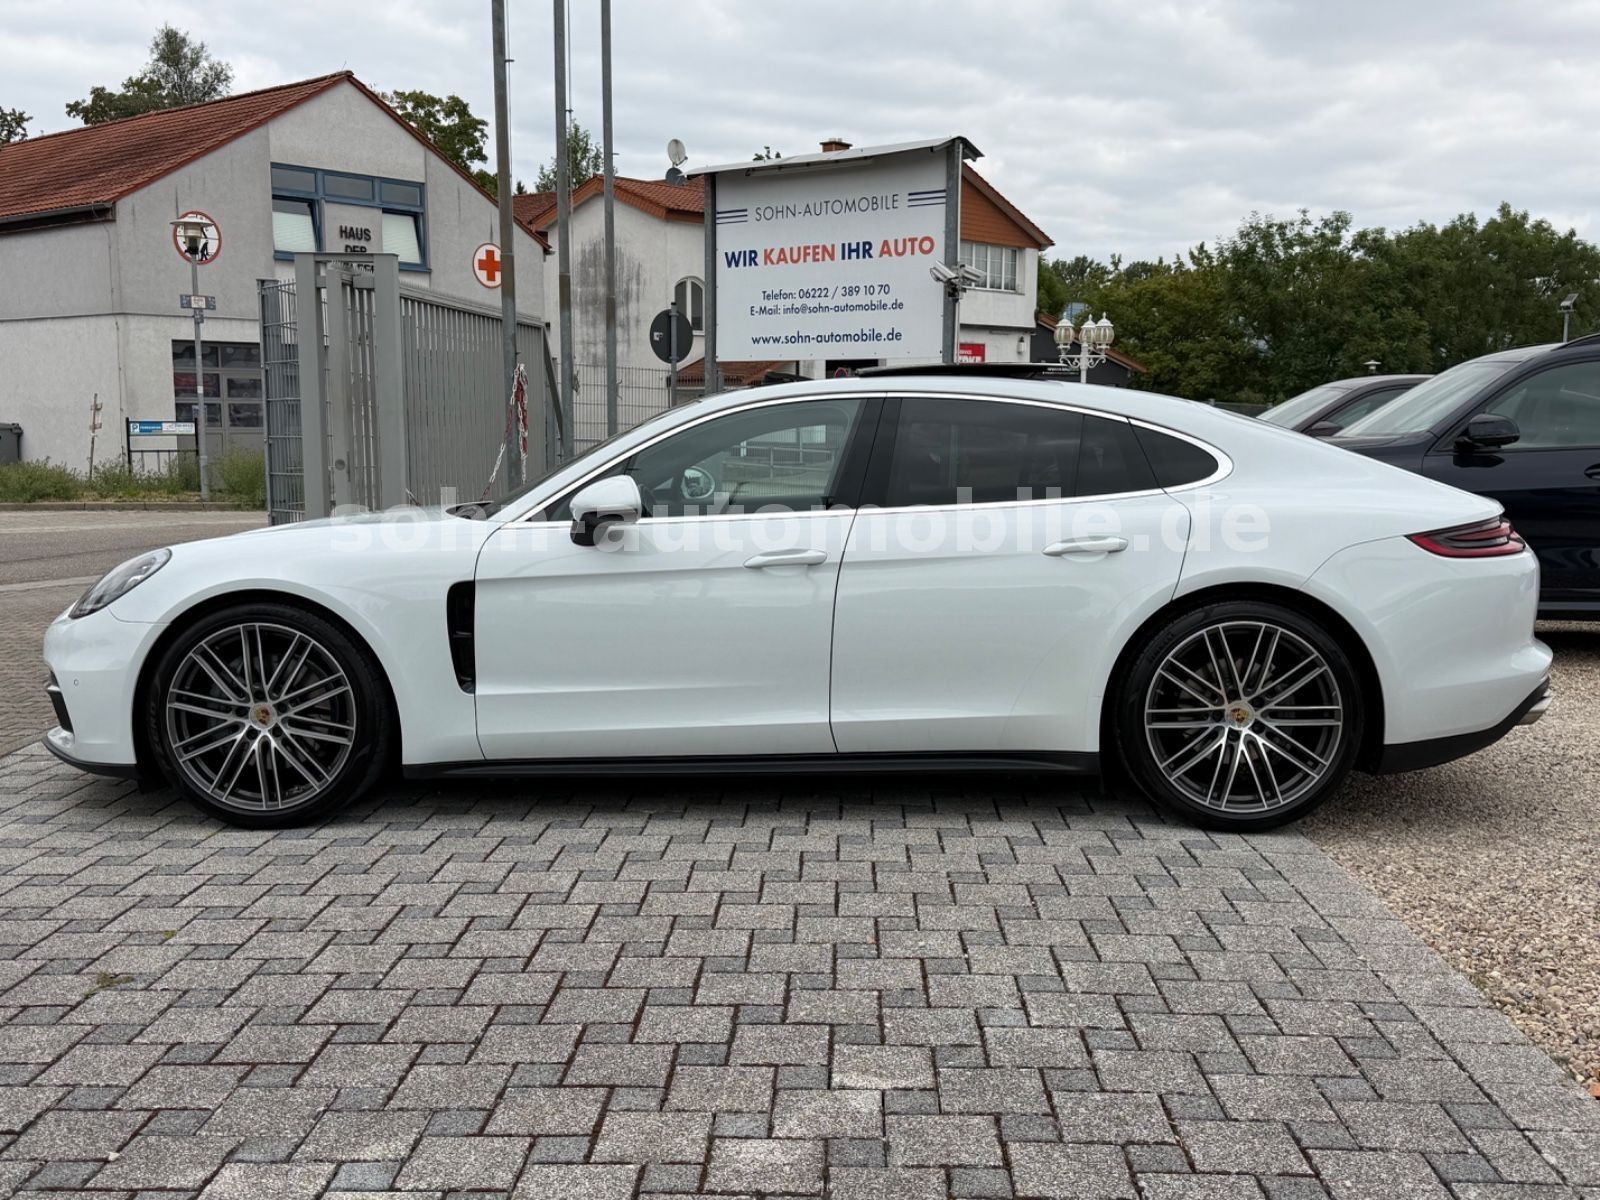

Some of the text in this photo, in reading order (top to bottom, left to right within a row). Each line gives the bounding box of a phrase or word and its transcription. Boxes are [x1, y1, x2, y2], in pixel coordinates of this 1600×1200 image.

[755, 194, 899, 221] SOHN-AUTOMOBILE
[339, 225, 372, 242] HAUS
[724, 235, 935, 268] WIR KAUFEN IHR AUTO
[761, 283, 890, 301] Telefon: 06222 / 389 10 70
[750, 299, 904, 316] E-Mail: info@sohn-automobile.de
[751, 327, 903, 345] www.sohn-automobile.de
